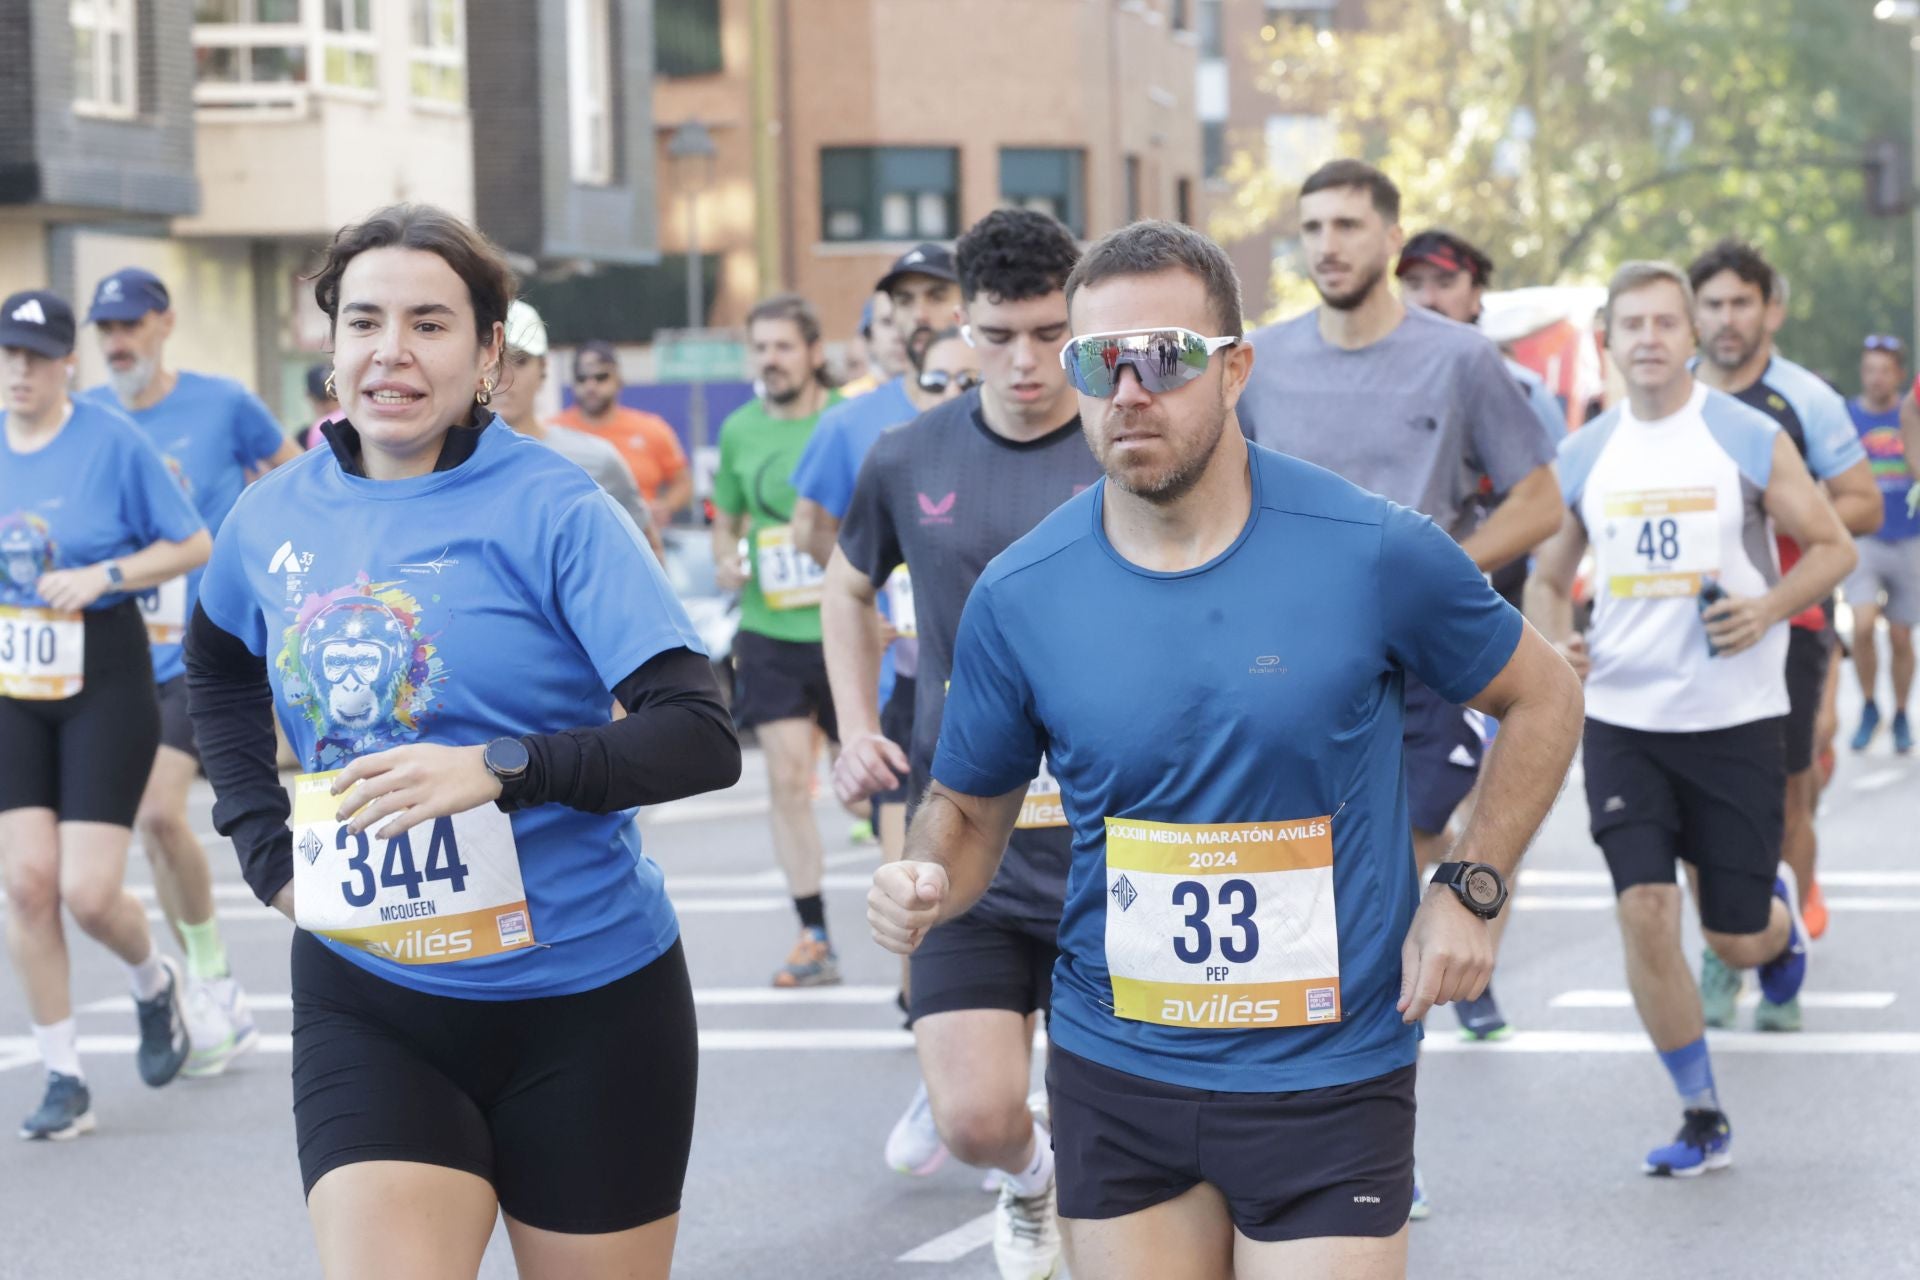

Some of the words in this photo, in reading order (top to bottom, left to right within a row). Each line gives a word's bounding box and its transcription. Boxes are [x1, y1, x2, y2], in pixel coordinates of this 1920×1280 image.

[1637, 518, 1679, 561] 48
[1, 622, 56, 665] 310
[1149, 829, 1192, 844] MEDIA
[1196, 826, 1274, 845] MARATÓN
[1277, 821, 1326, 841] AVILÉS
[335, 815, 469, 908] 344
[1188, 851, 1237, 868] 2024
[379, 900, 437, 922] MCQUEEN
[1172, 879, 1259, 964] 33
[1206, 966, 1229, 981] PEP
[1161, 994, 1281, 1023] avilés
[1353, 1195, 1381, 1204] KIPRUN
